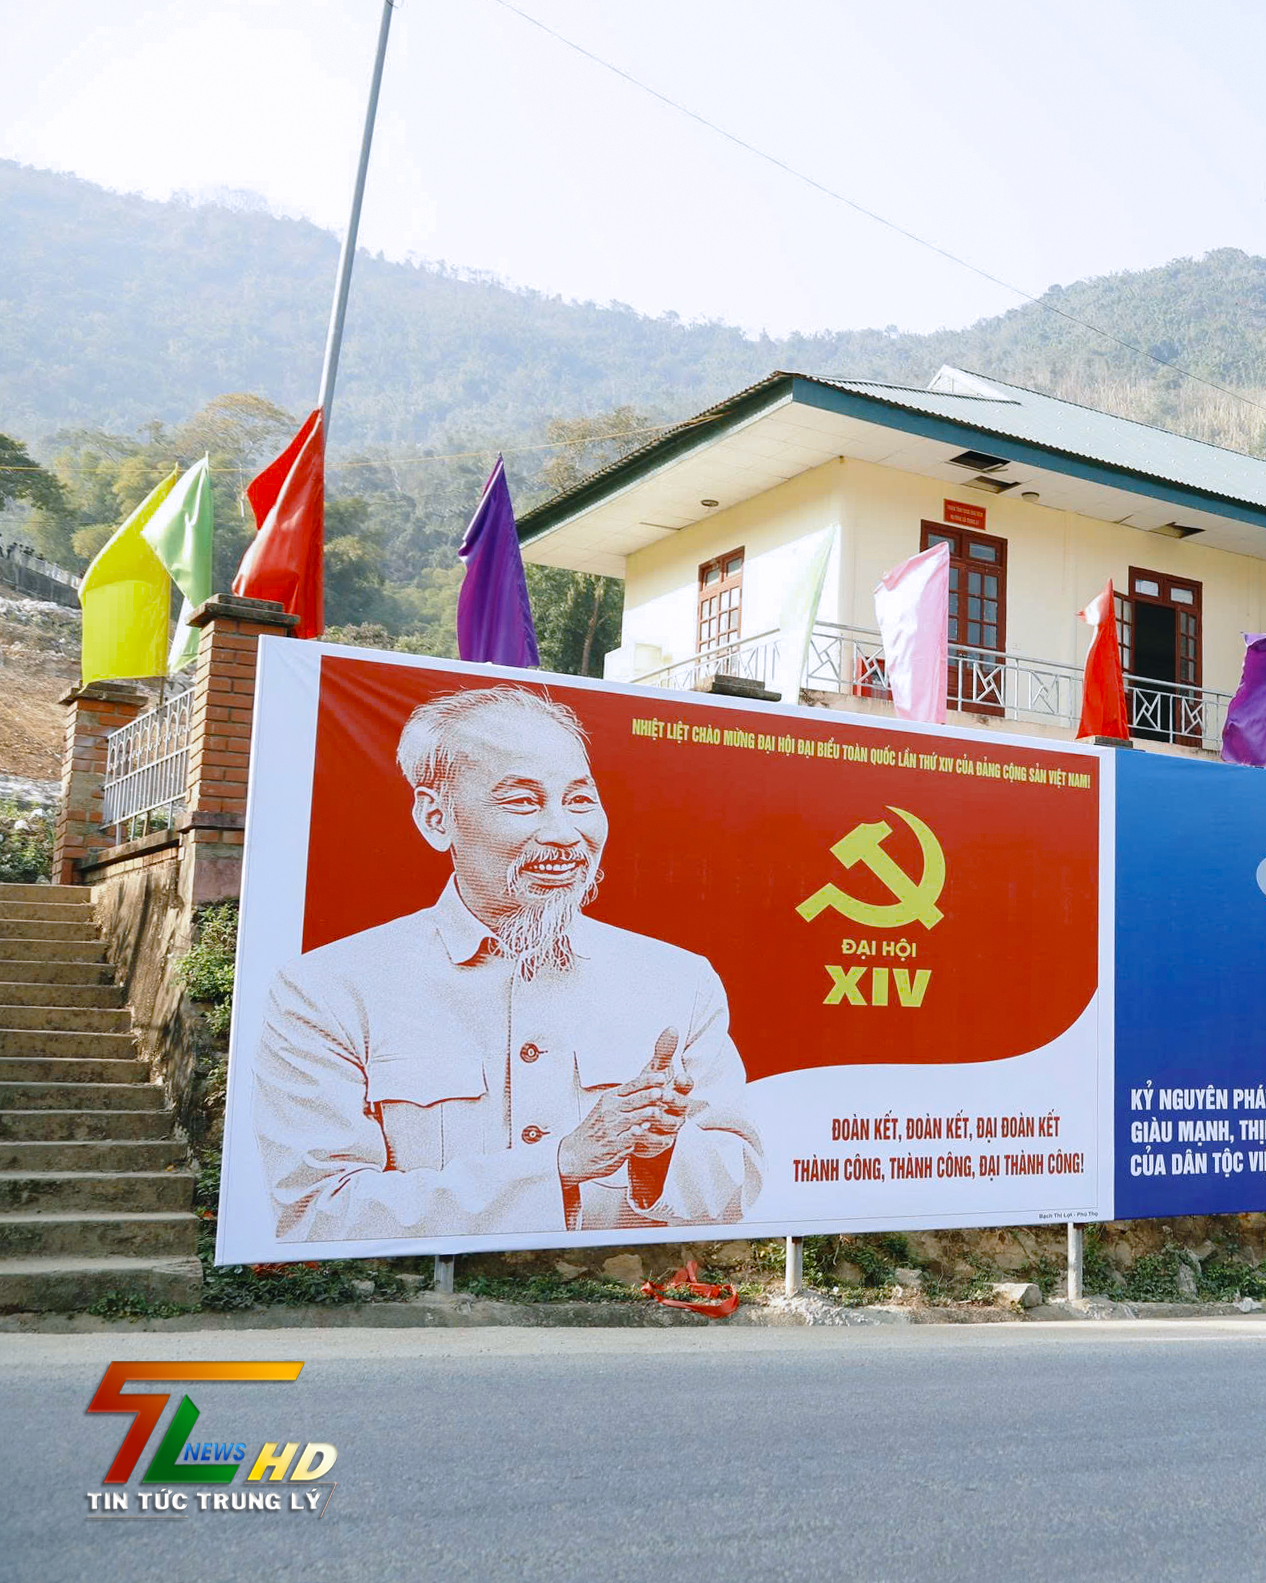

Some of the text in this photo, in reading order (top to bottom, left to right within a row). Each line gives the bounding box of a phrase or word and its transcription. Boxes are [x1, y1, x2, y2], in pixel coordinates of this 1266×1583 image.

[632, 718, 1091, 789] NHIỆT LIỆT CHÀO MỪNG ĐẠI HỘI ĐẠI BIỂU TOÀN QUỐC LẦN THỨ XIV CỦA ĐẢNG CỘNG SẢN VIỆT NAM!
[841, 938, 917, 962] ĐẠI HỘI
[822, 965, 932, 1008] XIV
[1131, 1079, 1154, 1110] KỶ
[1159, 1085, 1228, 1110] NGUYÊN
[832, 1109, 1060, 1143] ĐOÀN KẾT, ĐOÀN KẾT, ĐẠI ĐOÀN KẾT
[1131, 1117, 1172, 1143] GIÀU
[1178, 1120, 1234, 1146] MẠNH,
[793, 1149, 1084, 1182] THÀNH CÔNG, THÀNH CÔNG, ĐẠI THÀNH CÔNG!
[1130, 1145, 1166, 1176] CỦA
[1172, 1148, 1207, 1175] DÂN
[1212, 1148, 1244, 1177] TỘC
